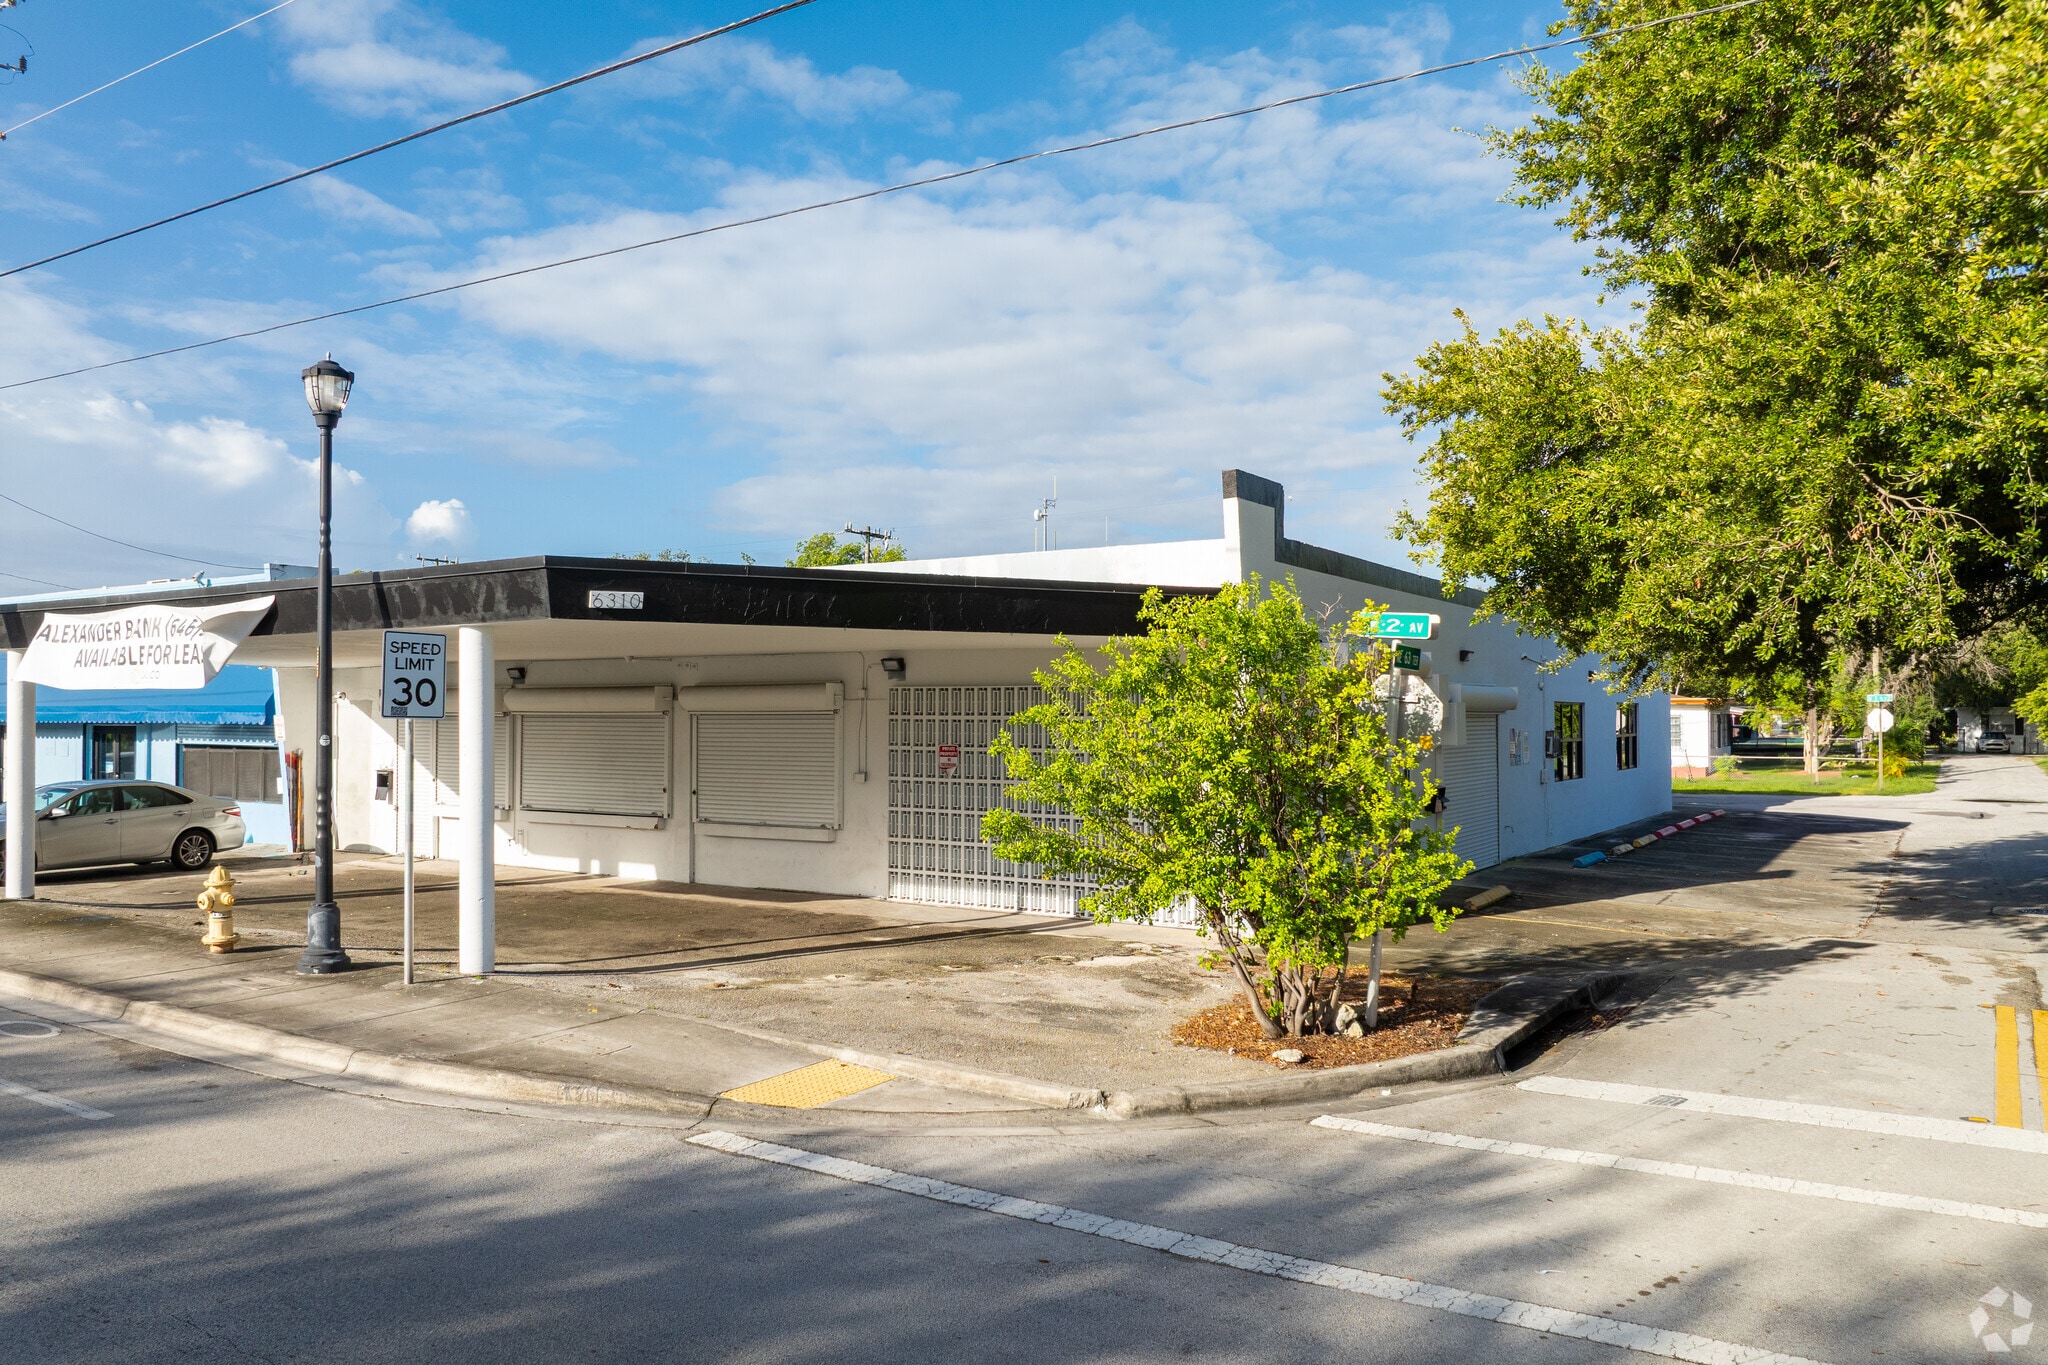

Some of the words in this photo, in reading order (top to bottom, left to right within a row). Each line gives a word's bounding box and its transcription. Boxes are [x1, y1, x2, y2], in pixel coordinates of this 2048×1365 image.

[592, 593, 641, 609] 6310
[36, 621, 121, 643] ALEXANDER
[125, 617, 162, 639] BANK
[1408, 621, 1424, 634] AV
[74, 645, 145, 668] AVAILABLE
[147, 644, 172, 665] FOR
[390, 641, 441, 656] SPEED
[395, 657, 435, 671] LIMIT
[392, 677, 436, 707] 30
